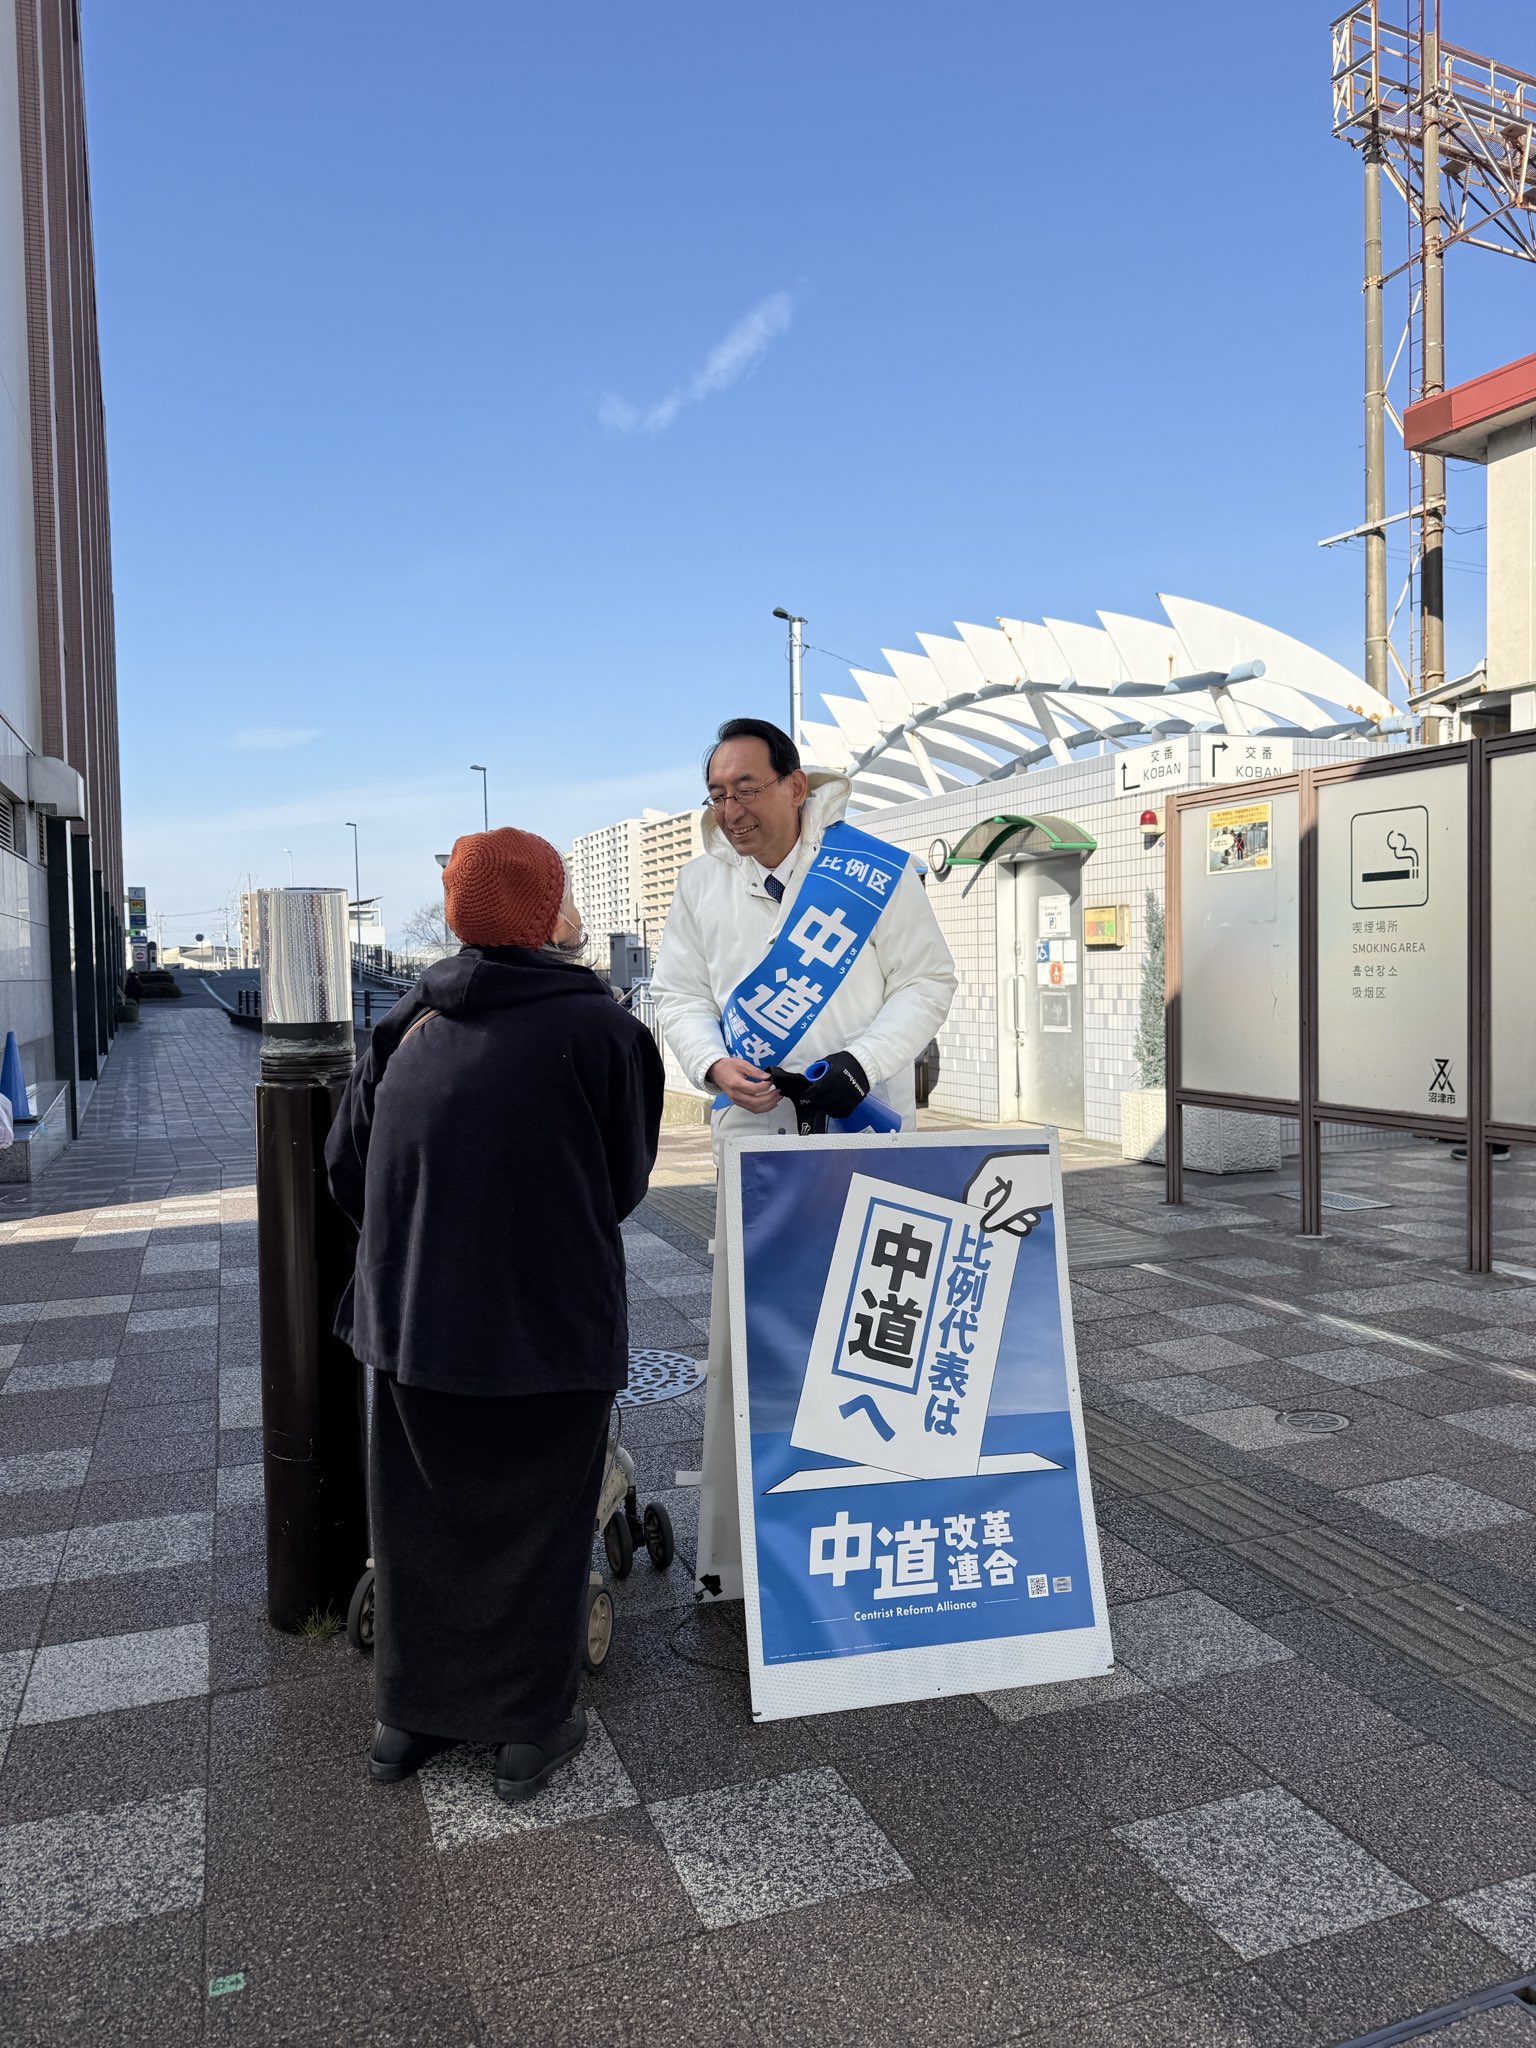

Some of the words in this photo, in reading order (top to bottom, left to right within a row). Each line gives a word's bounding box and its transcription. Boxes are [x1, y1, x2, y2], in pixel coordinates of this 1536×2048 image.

[1151, 745, 1173, 764] 交番
[1245, 746, 1272, 760] 交番
[1143, 762, 1181, 781] KOBAN
[1236, 765, 1282, 778] KOBAN
[818, 855, 893, 896] 比例区
[1352, 920, 1398, 934] 喫煙場所
[839, 947, 857, 975] ちゅう
[1352, 965, 1398, 977] 흡연장소
[736, 906, 858, 1041] 中道
[1352, 986, 1386, 999] 吸烟区
[1428, 1092, 1456, 1104] 沼津市
[924, 1223, 994, 1436] 比例代表は
[943, 1510, 1014, 1551] 改革
[808, 1510, 939, 1600] 中道
[947, 1548, 1018, 1592] 連合
[854, 1608, 894, 1621] Centrist
[896, 1604, 934, 1617] Reform
[936, 1600, 978, 1613] Alliance
